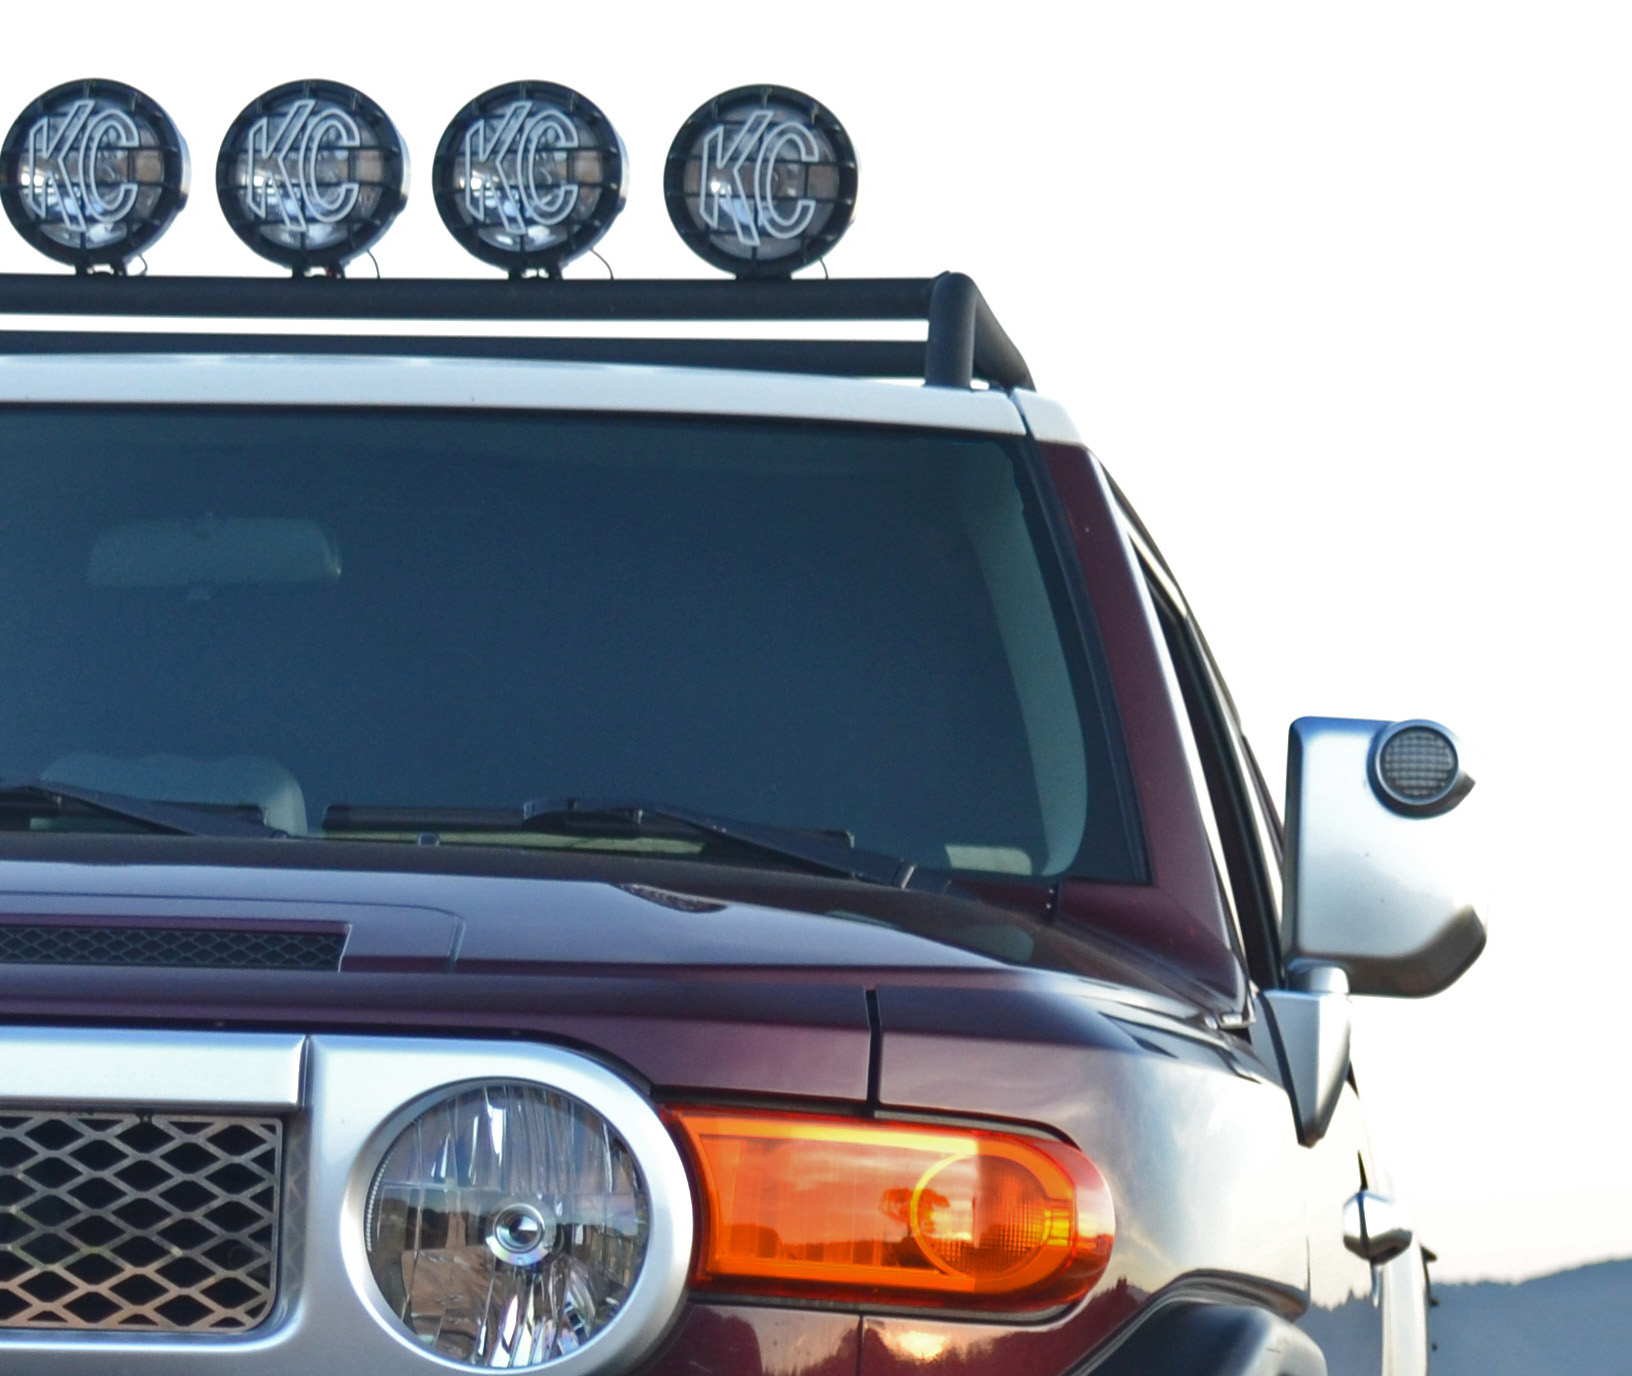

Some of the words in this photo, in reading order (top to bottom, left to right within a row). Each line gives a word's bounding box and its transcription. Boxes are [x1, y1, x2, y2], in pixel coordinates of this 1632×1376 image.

[28, 99, 140, 232] KC
[247, 99, 361, 232] KC
[464, 101, 580, 235] KC
[699, 109, 821, 247] KC
